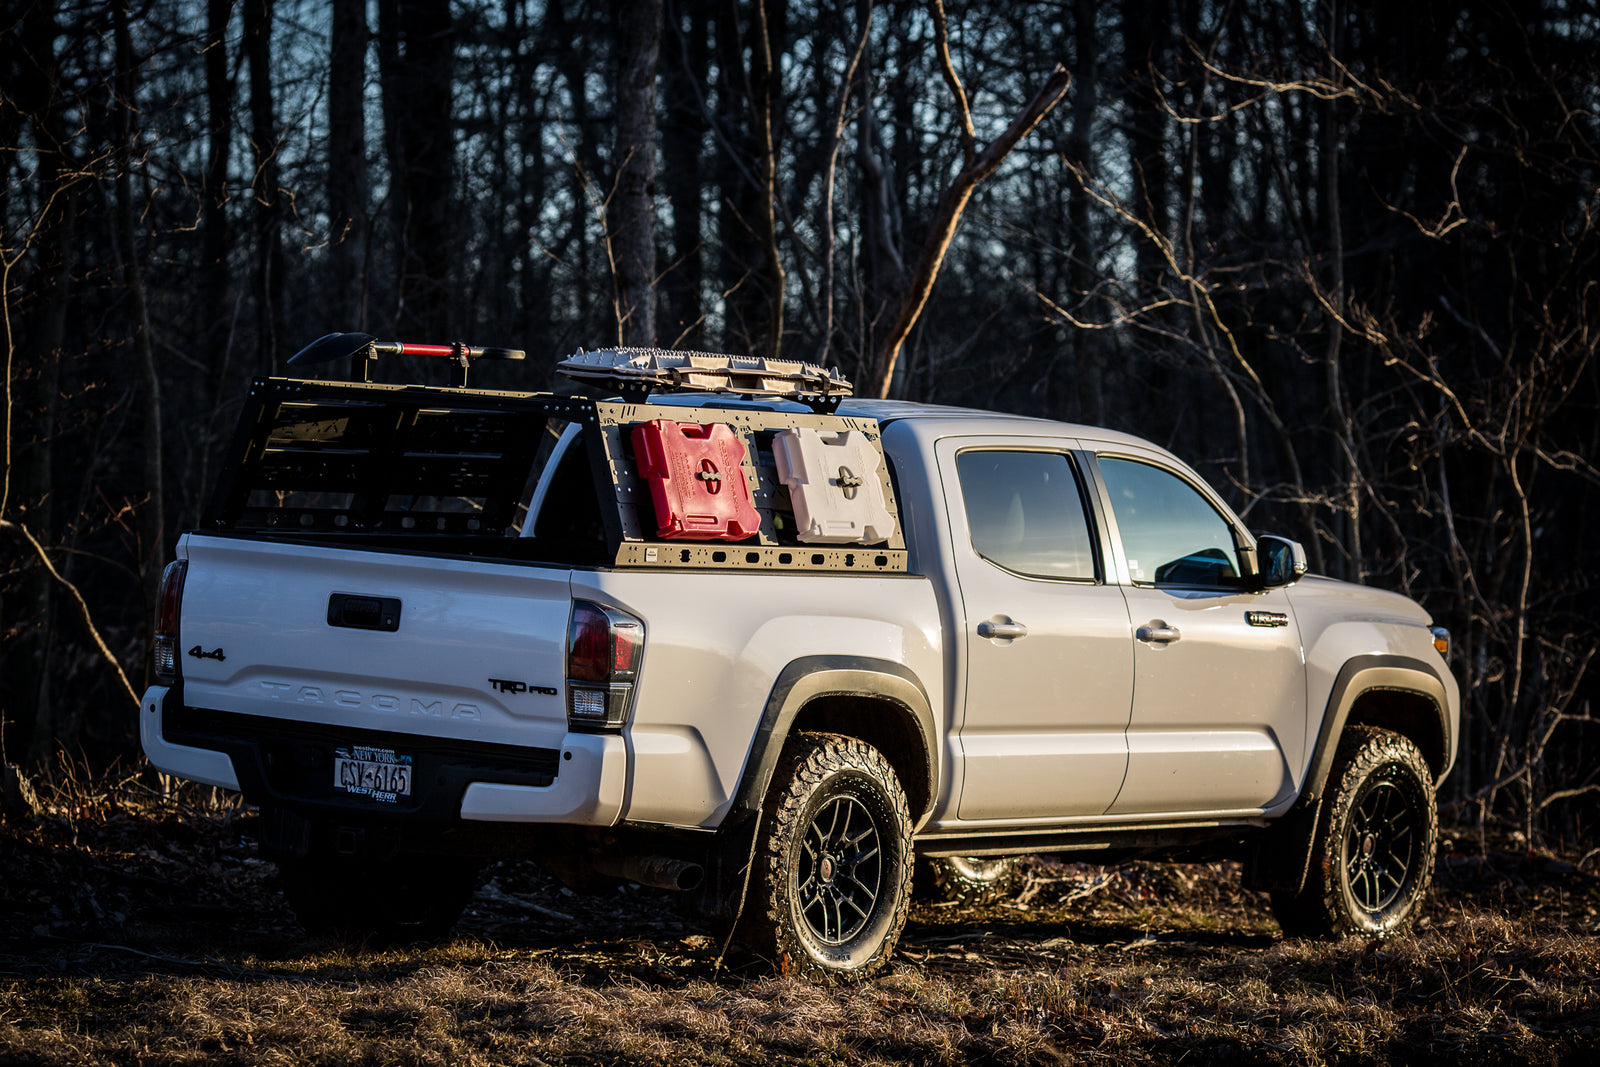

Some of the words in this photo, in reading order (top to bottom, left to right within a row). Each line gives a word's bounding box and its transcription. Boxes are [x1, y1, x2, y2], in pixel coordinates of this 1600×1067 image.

[188, 645, 226, 661] 4x4
[487, 678, 527, 695] TRD
[528, 685, 558, 696] PRO
[260, 681, 482, 722] TACOMA
[354, 750, 372, 761] NEW
[375, 751, 395, 763] YORK
[374, 765, 407, 792] 6165
